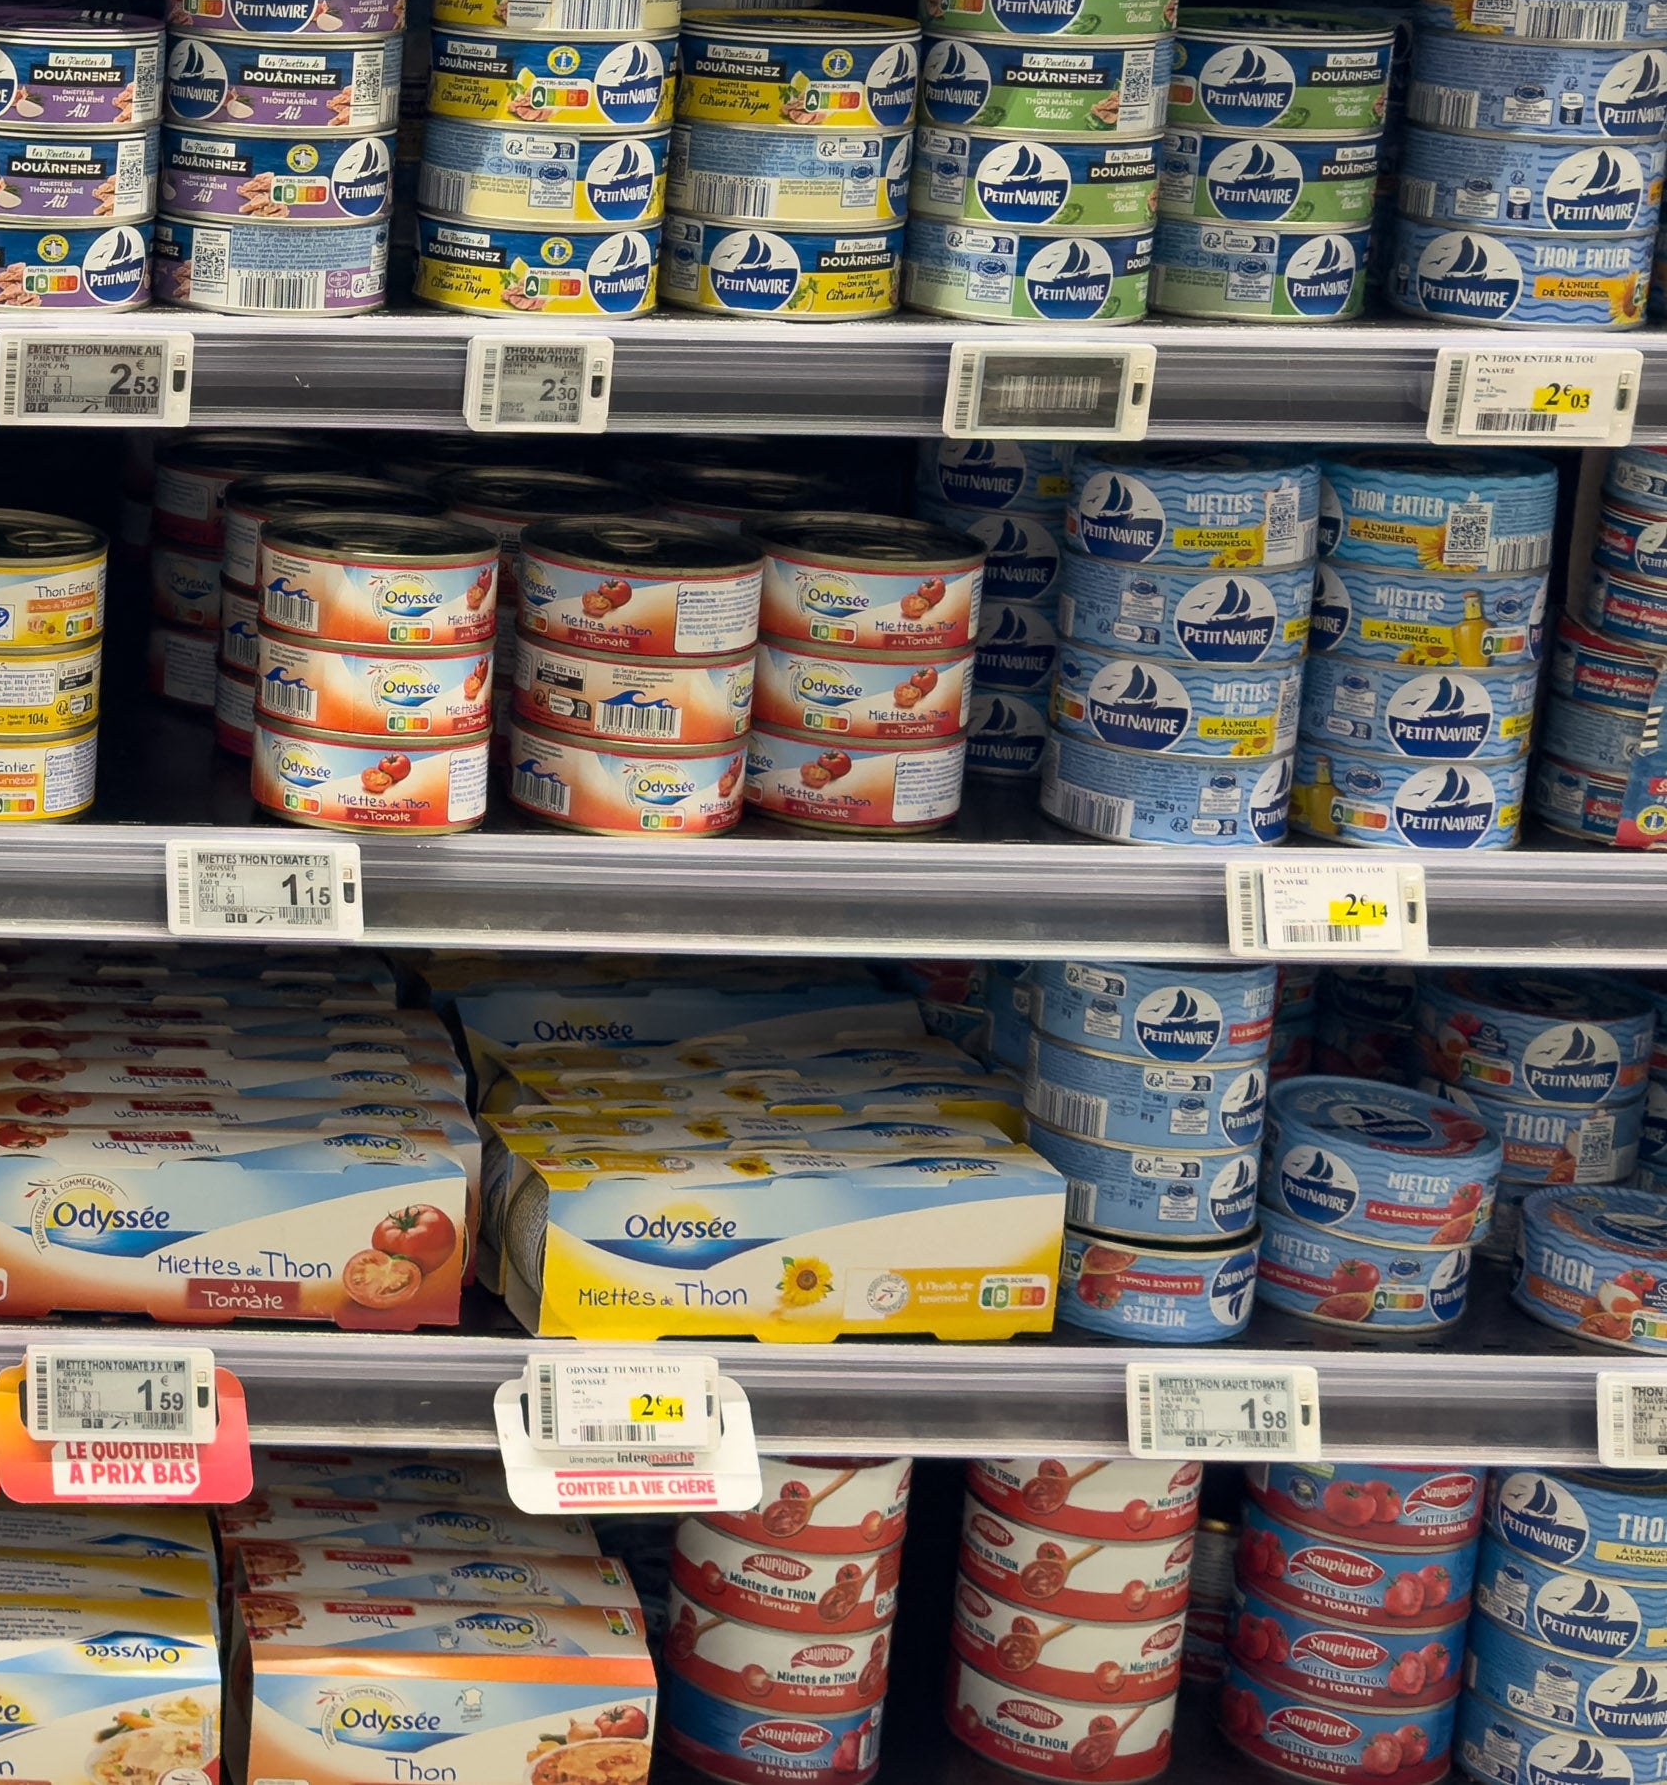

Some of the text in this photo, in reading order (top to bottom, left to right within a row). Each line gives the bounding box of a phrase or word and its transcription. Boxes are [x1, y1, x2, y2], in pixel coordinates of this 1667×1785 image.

[66, 103, 89, 118] Ail
[1352, 491, 1443, 517] THON ENTIER
[638, 780, 694, 797] Odyssée
[157, 1255, 242, 1276] Miettes
[265, 1252, 332, 1279] Thon
[203, 1292, 283, 1309] Tomate
[1305, 1551, 1374, 1578] Saupiquet
